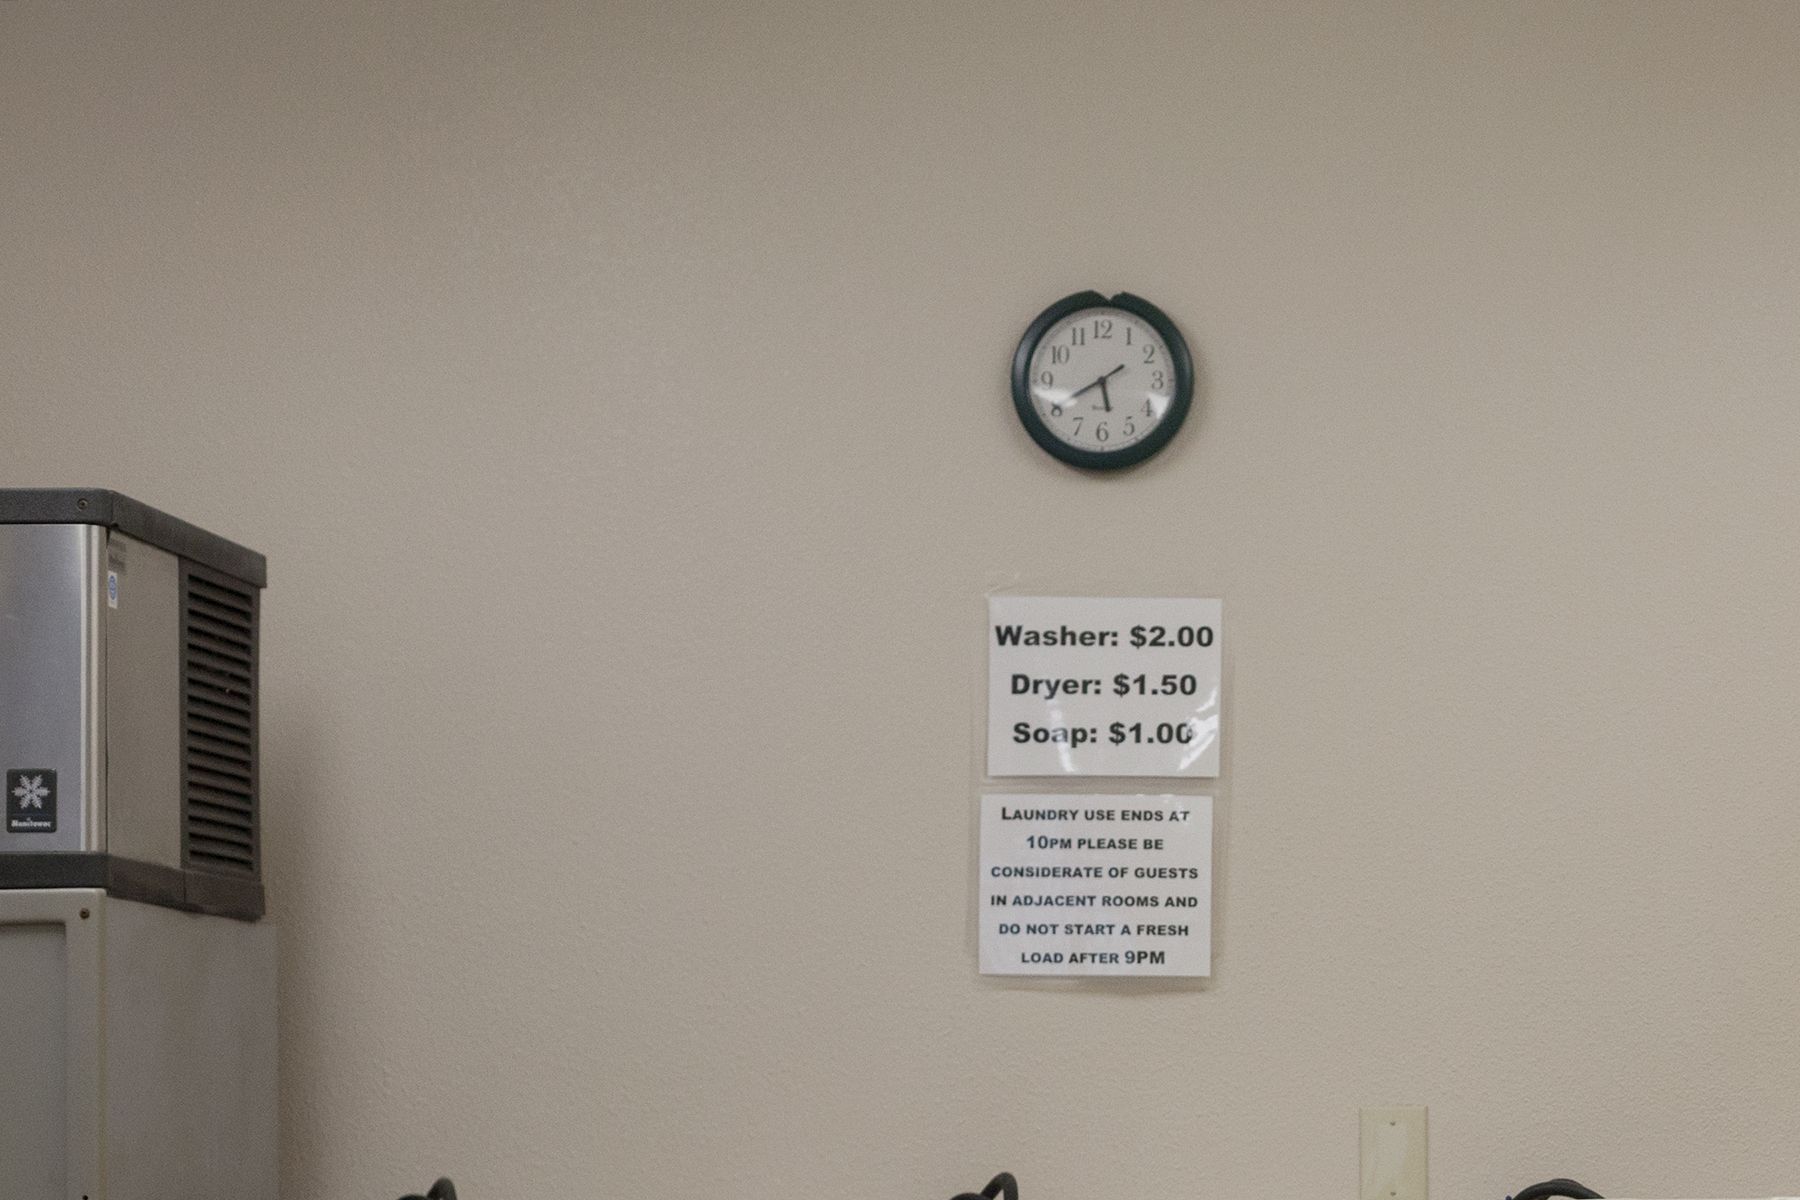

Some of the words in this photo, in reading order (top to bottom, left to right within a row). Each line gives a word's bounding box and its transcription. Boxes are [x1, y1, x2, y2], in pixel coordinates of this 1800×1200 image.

[1072, 327, 1086, 346] 11
[1093, 320, 1113, 339] 12
[1126, 327, 1132, 345] 1
[1052, 346, 1070, 364] 10
[1143, 345, 1155, 364] 2
[1041, 371, 1053, 389] 9
[1151, 372, 1164, 390] 3
[1141, 398, 1153, 417] 4
[1073, 417, 1084, 436] 7
[1096, 422, 1109, 441] 6
[1123, 417, 1135, 435] 5
[995, 625, 1118, 647] Washer:
[1130, 625, 1214, 649] $2.00
[1011, 674, 1101, 699] Dryer:
[1113, 674, 1197, 698] $1.50
[1013, 723, 1097, 748] Soap:
[1109, 722, 1193, 746] $1.00
[1001, 807, 1079, 821] LAUNDRY
[1084, 810, 1115, 821] USE
[1121, 810, 1164, 821] ENDS
[1168, 811, 1190, 822] AT
[1026, 836, 1072, 849] 10PM
[1077, 838, 1137, 850] PLEASE
[1143, 839, 1164, 850] BE
[991, 867, 1103, 878] CONSIDERATE
[1108, 868, 1129, 878] OF
[1134, 868, 1199, 879] GUESTS
[991, 895, 1007, 906] IN
[1013, 895, 1096, 907] ADJACENT
[1102, 896, 1159, 907] ROOMS
[1165, 897, 1198, 908] AND
[999, 924, 1021, 935] DO
[1026, 924, 1059, 935] NOT
[1065, 924, 1116, 935] START
[1121, 924, 1131, 935] A
[1137, 925, 1189, 936] FRESH
[1021, 952, 1063, 964] LOAD
[1068, 953, 1119, 964] AFTER
[1124, 951, 1165, 964] 9PM
